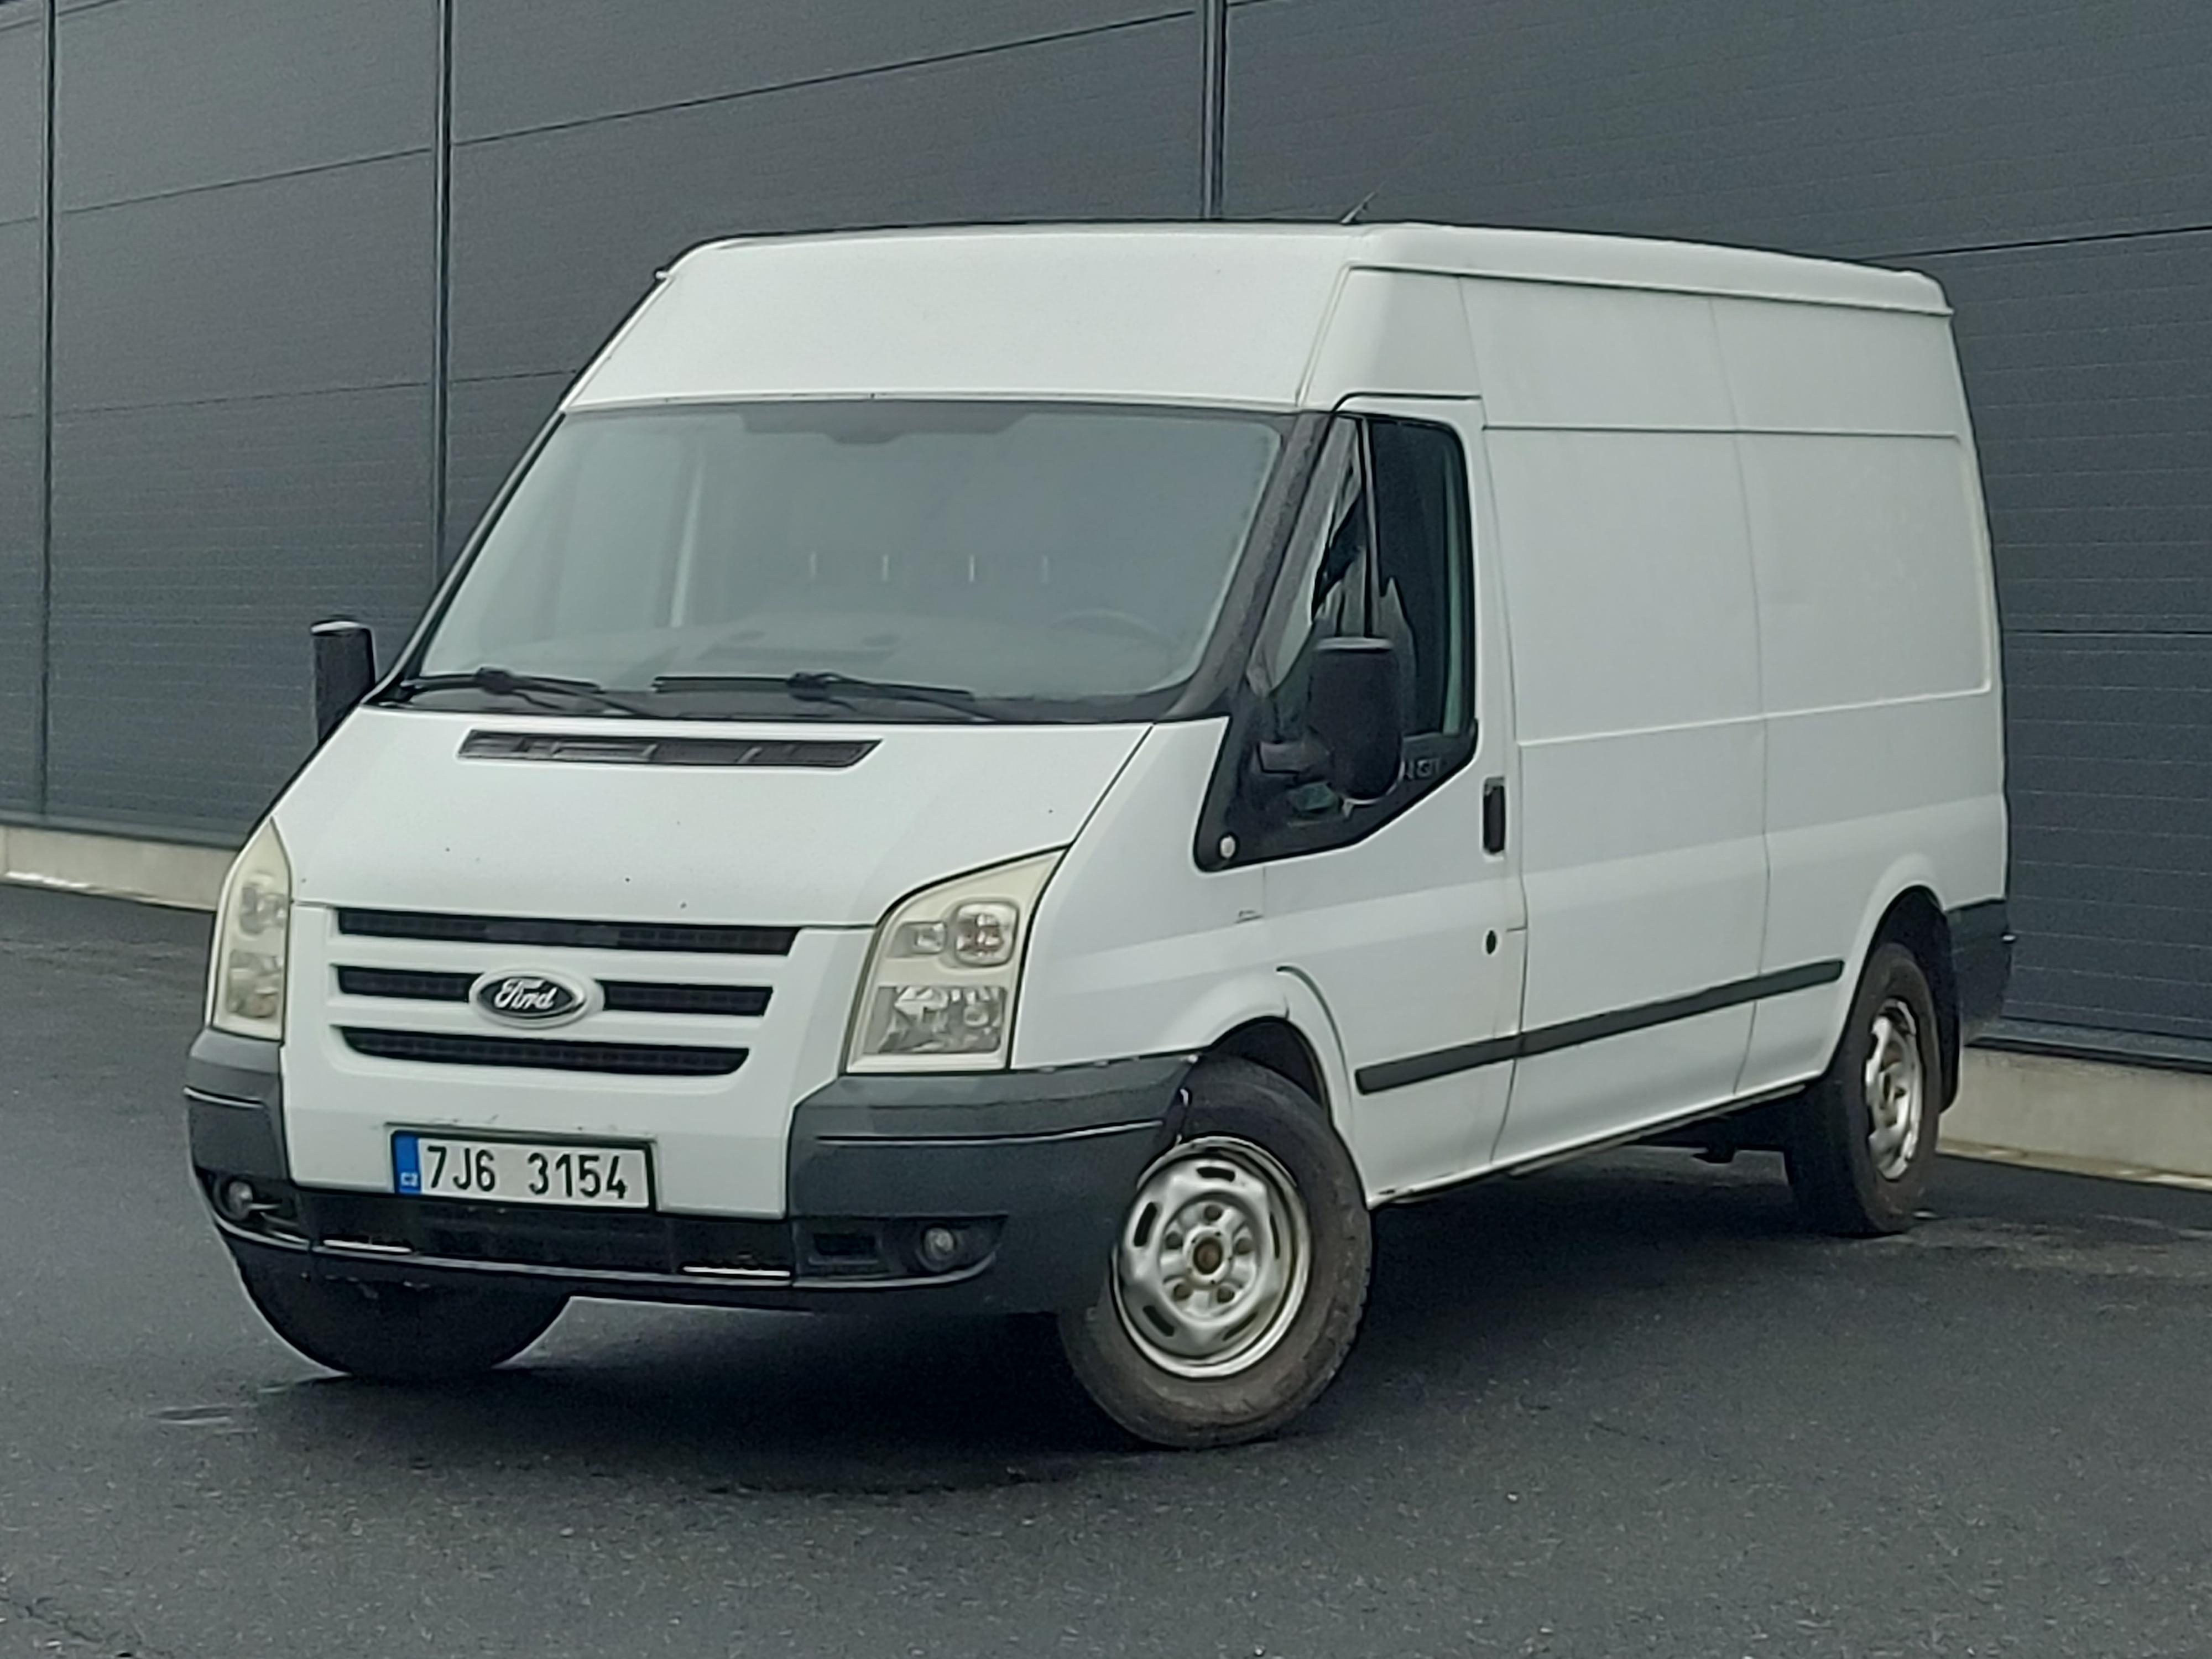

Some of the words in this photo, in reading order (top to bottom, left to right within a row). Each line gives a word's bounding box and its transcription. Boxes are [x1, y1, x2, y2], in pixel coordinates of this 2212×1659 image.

[494, 978, 557, 1009] Ford
[427, 1145, 495, 1192] 7J6
[527, 1152, 628, 1199] 3154
